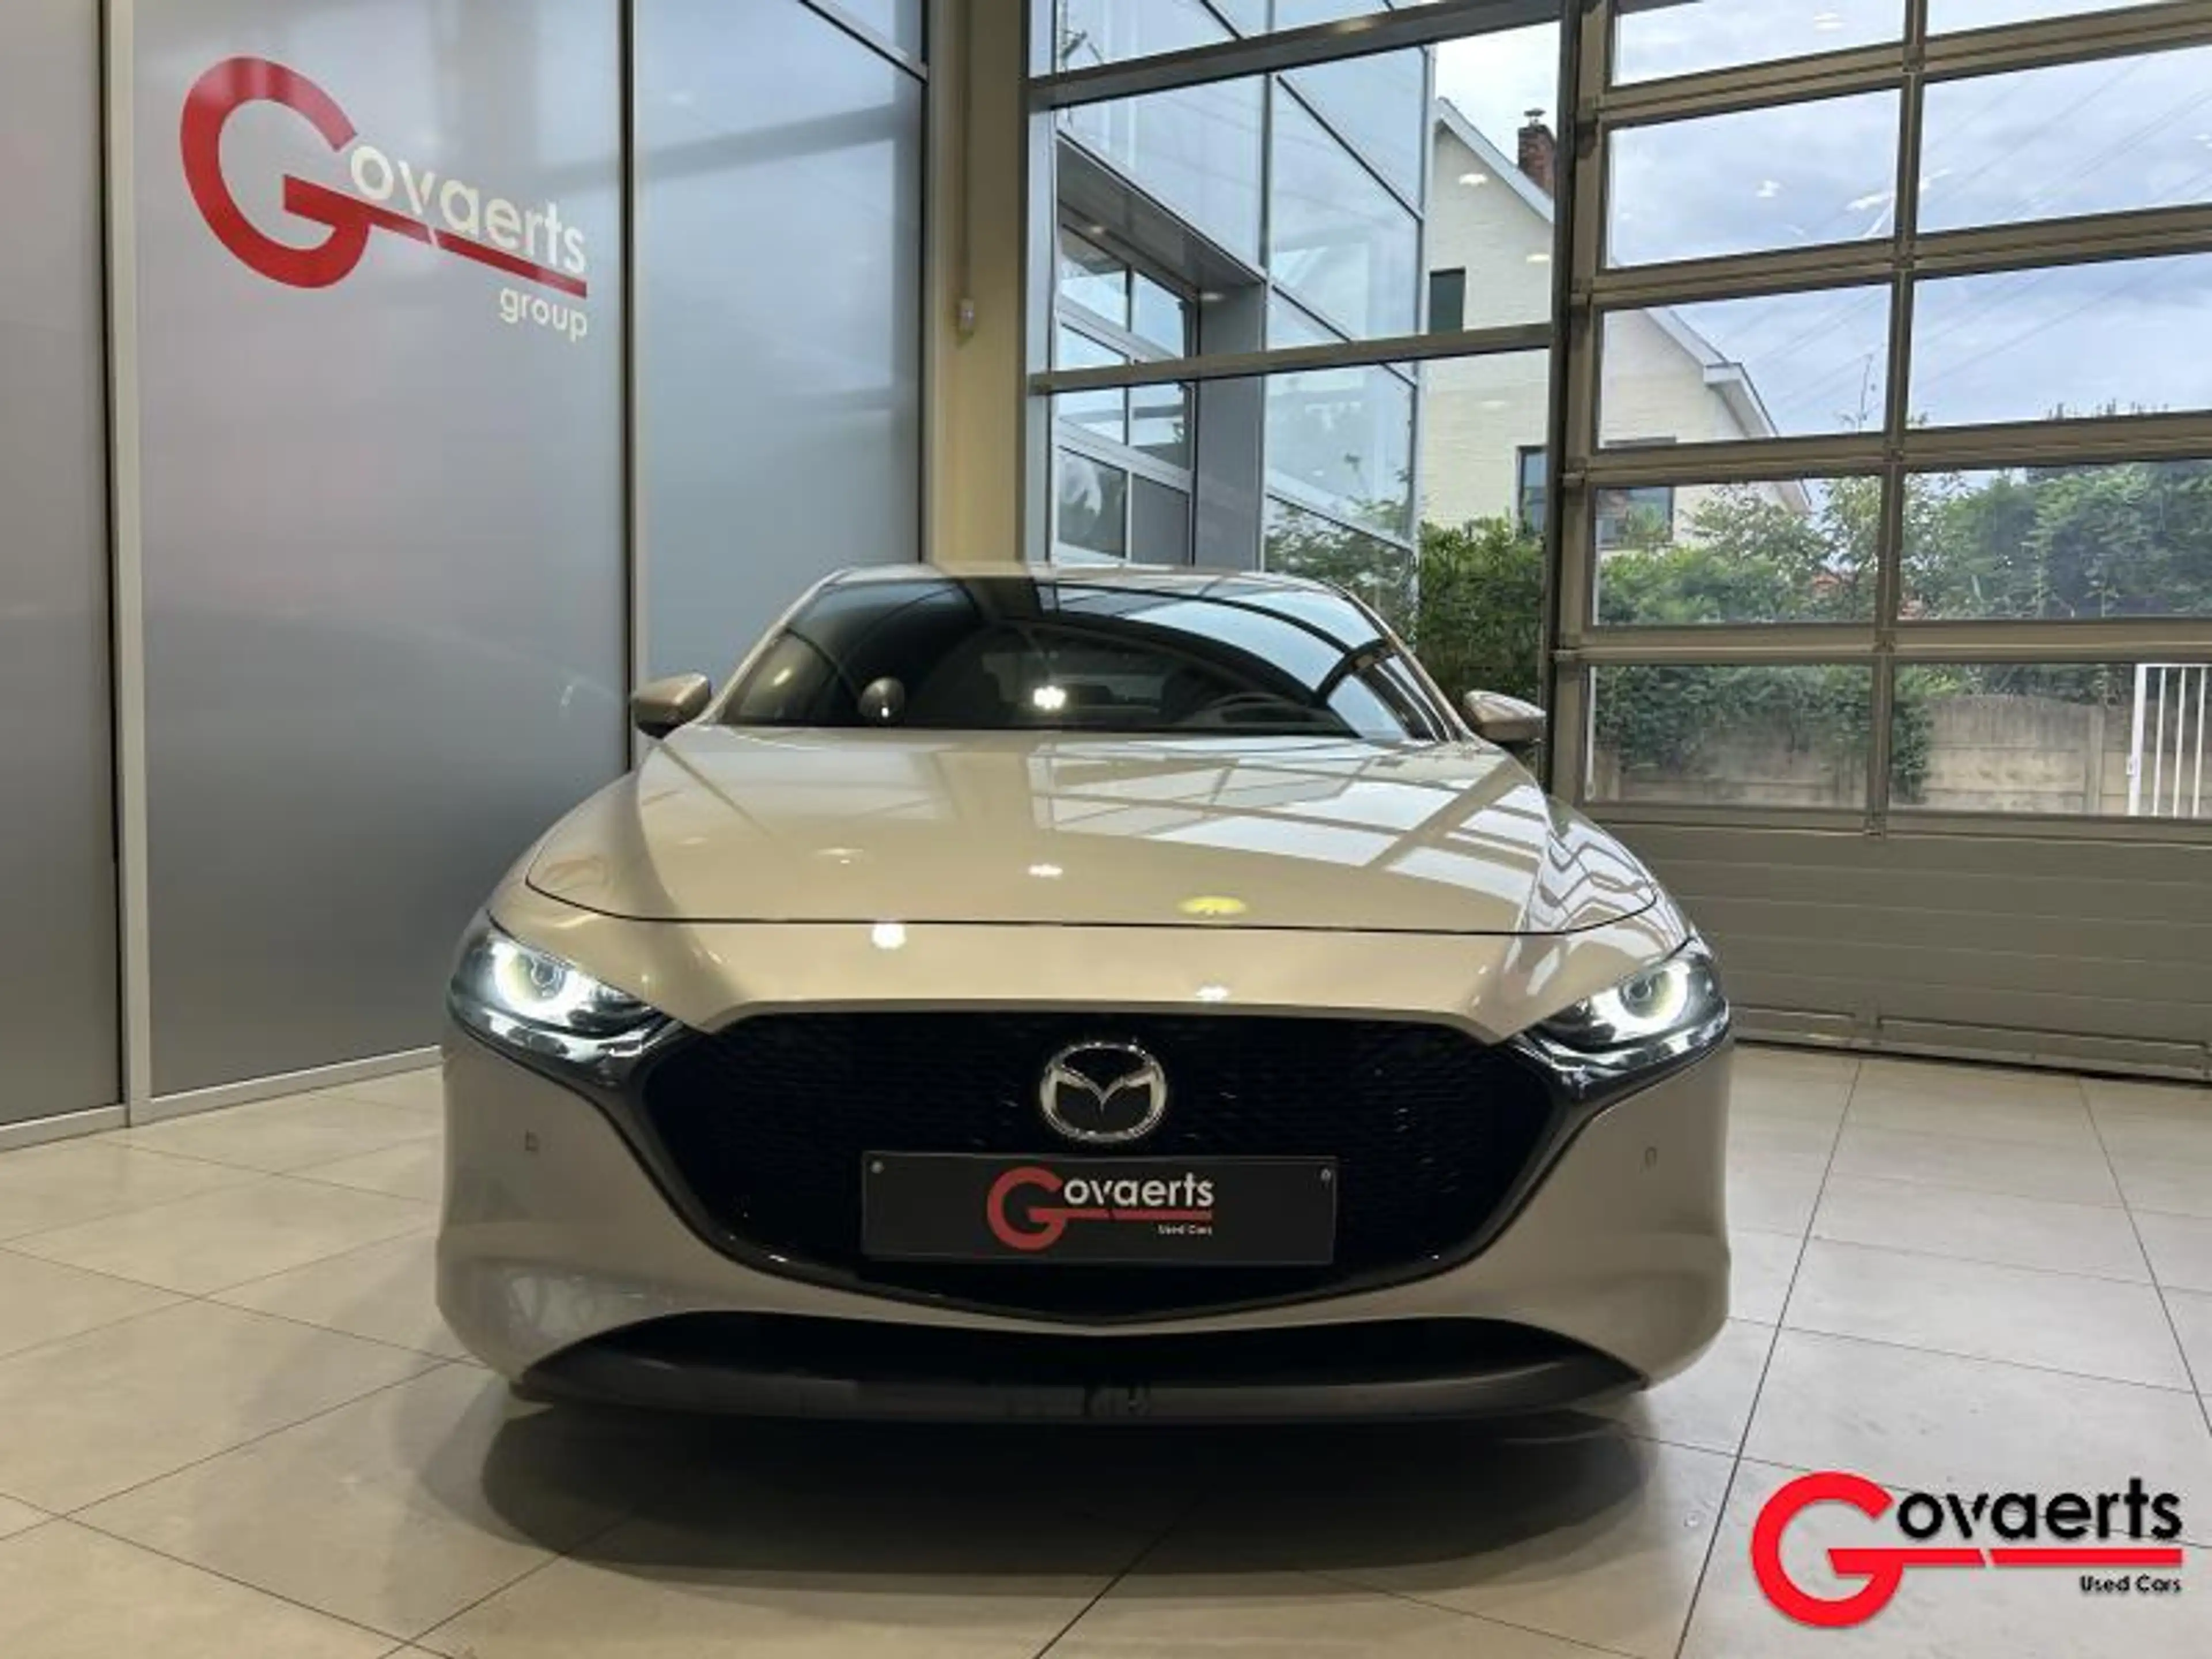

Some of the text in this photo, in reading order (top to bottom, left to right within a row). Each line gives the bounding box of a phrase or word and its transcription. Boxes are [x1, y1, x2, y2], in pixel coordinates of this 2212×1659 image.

[180, 56, 587, 299] Govaerts
[499, 286, 588, 342] group
[987, 1166, 1215, 1251] Govaerts
